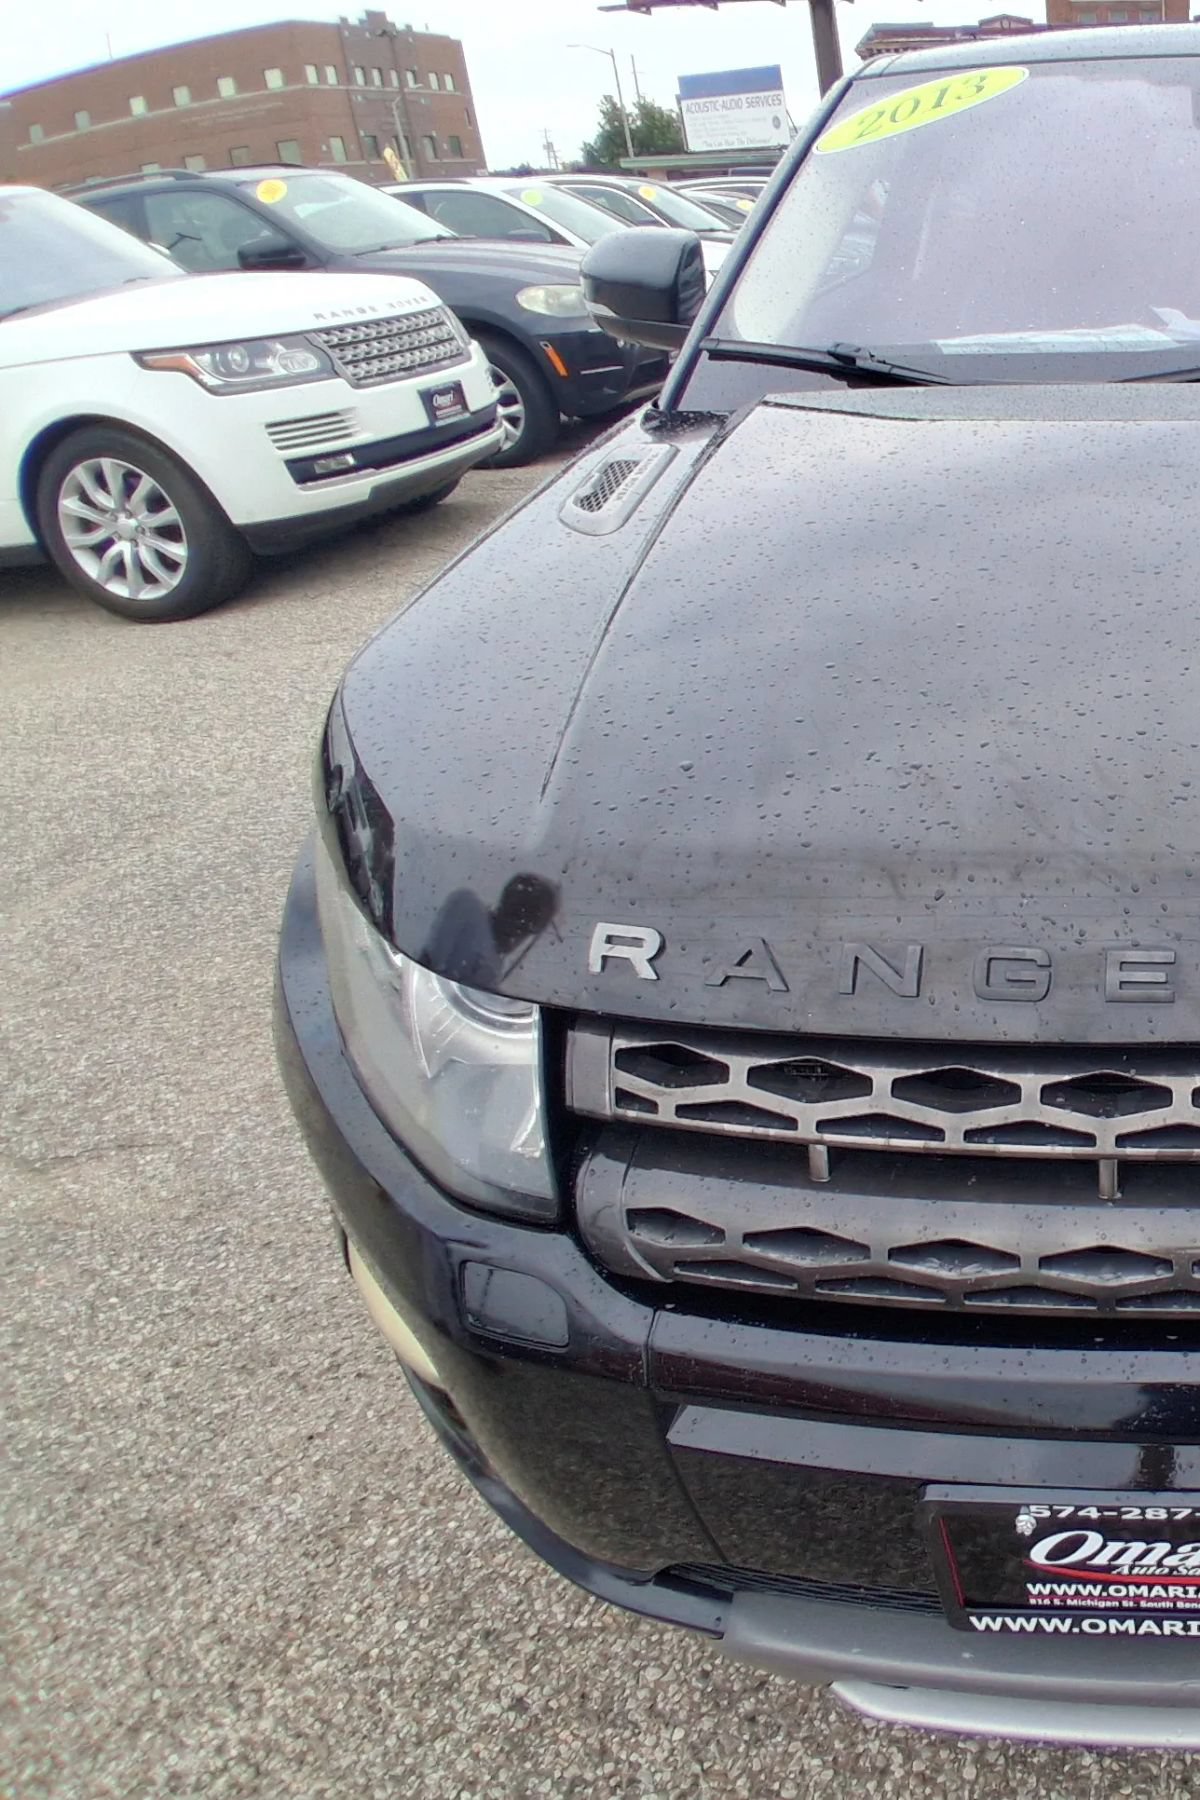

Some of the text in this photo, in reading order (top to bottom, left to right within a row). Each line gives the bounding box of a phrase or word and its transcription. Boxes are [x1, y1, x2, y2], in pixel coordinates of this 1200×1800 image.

[746, 94, 782, 109] SERVICES
[855, 76, 987, 140] 2013
[587, 922, 1177, 1004] RANGE
[1111, 1564, 1169, 1576] Auto
[1066, 1598, 1119, 1609] Michigan
[1140, 1600, 1174, 1609] South
